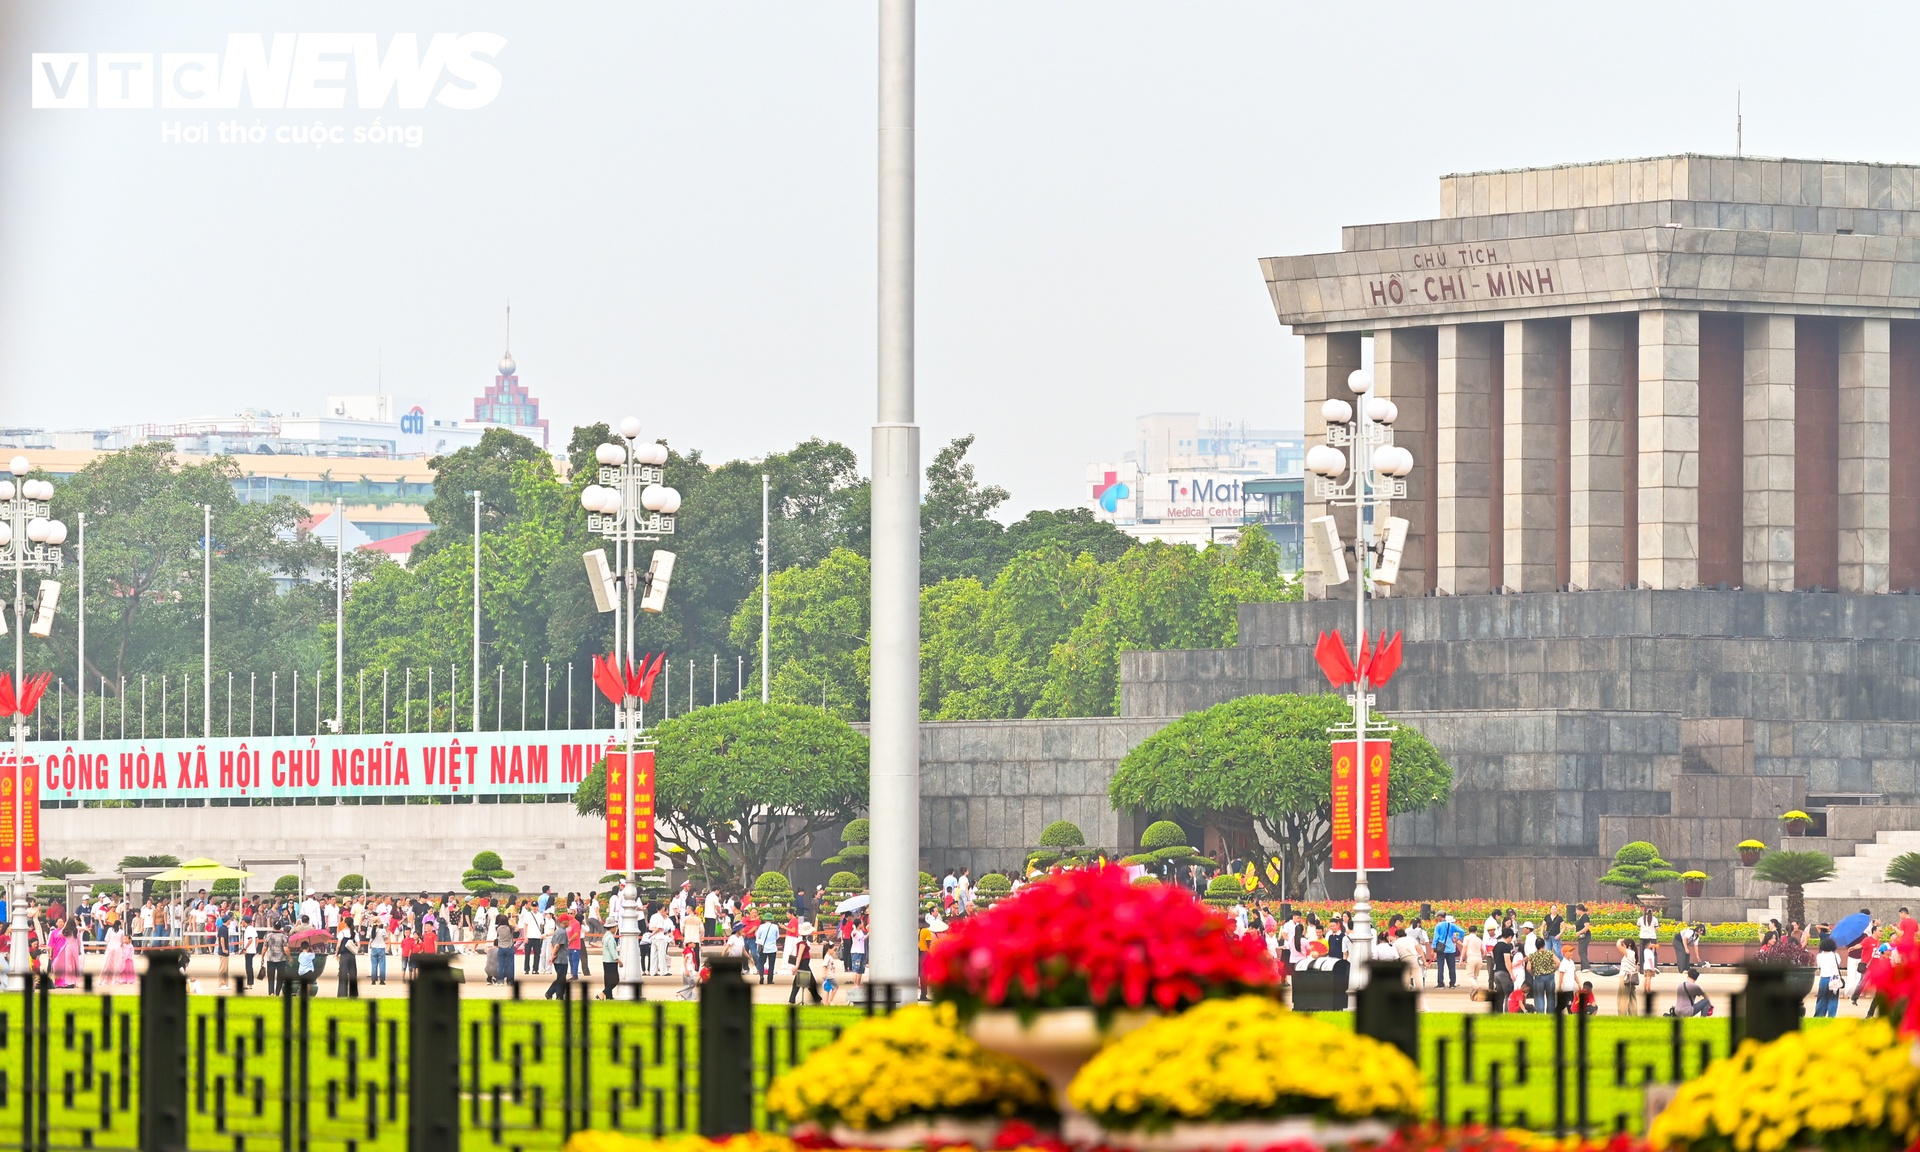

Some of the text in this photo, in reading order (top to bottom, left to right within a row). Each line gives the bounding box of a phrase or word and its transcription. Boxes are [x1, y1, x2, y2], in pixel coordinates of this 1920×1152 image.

[1167, 507, 1243, 517] Medical Center
[46, 746, 109, 797] CỘNG
[119, 745, 168, 791] HÒA
[177, 744, 210, 789] XÃ
[219, 743, 260, 795] HỘI
[271, 737, 320, 787] CHỦ
[331, 740, 410, 786] NGHĨA
[422, 738, 478, 792] VIỆT
[490, 744, 548, 784] NAM
